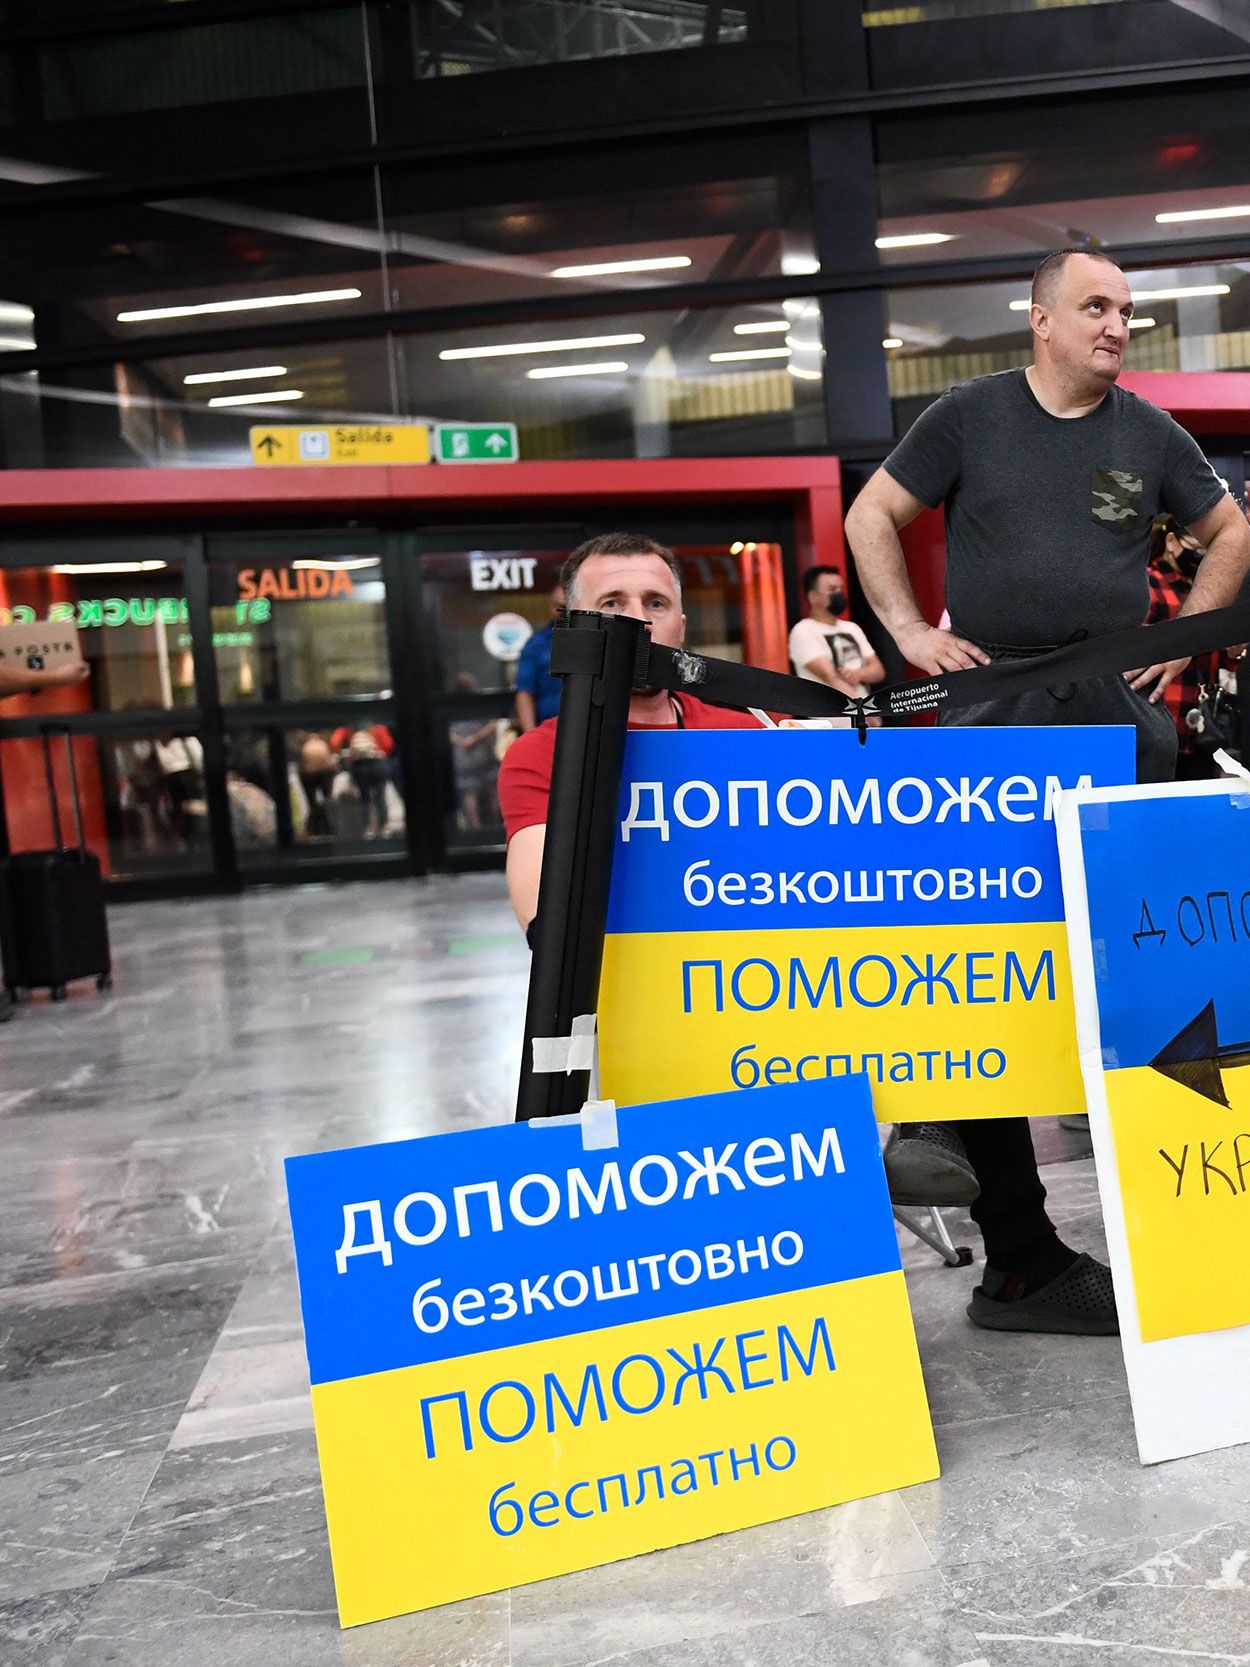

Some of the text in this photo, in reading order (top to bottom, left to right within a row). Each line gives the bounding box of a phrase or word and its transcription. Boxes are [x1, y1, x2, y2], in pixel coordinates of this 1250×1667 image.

[336, 428, 393, 445] Salida
[237, 567, 356, 601] SALIDA
[470, 556, 538, 591] EXIT
[890, 683, 939, 700] Aeropuerto
[890, 690, 949, 708] Internacional
[905, 701, 938, 712] Tijuana
[683, 860, 1043, 907] безкоштовно
[681, 949, 1057, 1014] ПОМОЖЕМ
[730, 1044, 1008, 1089] бесплатно
[335, 1126, 846, 1275] допоможем
[412, 1230, 805, 1334] безкоштовно
[418, 1316, 838, 1460] ПОМОЖЕМ
[488, 1435, 798, 1538] бесплатно
